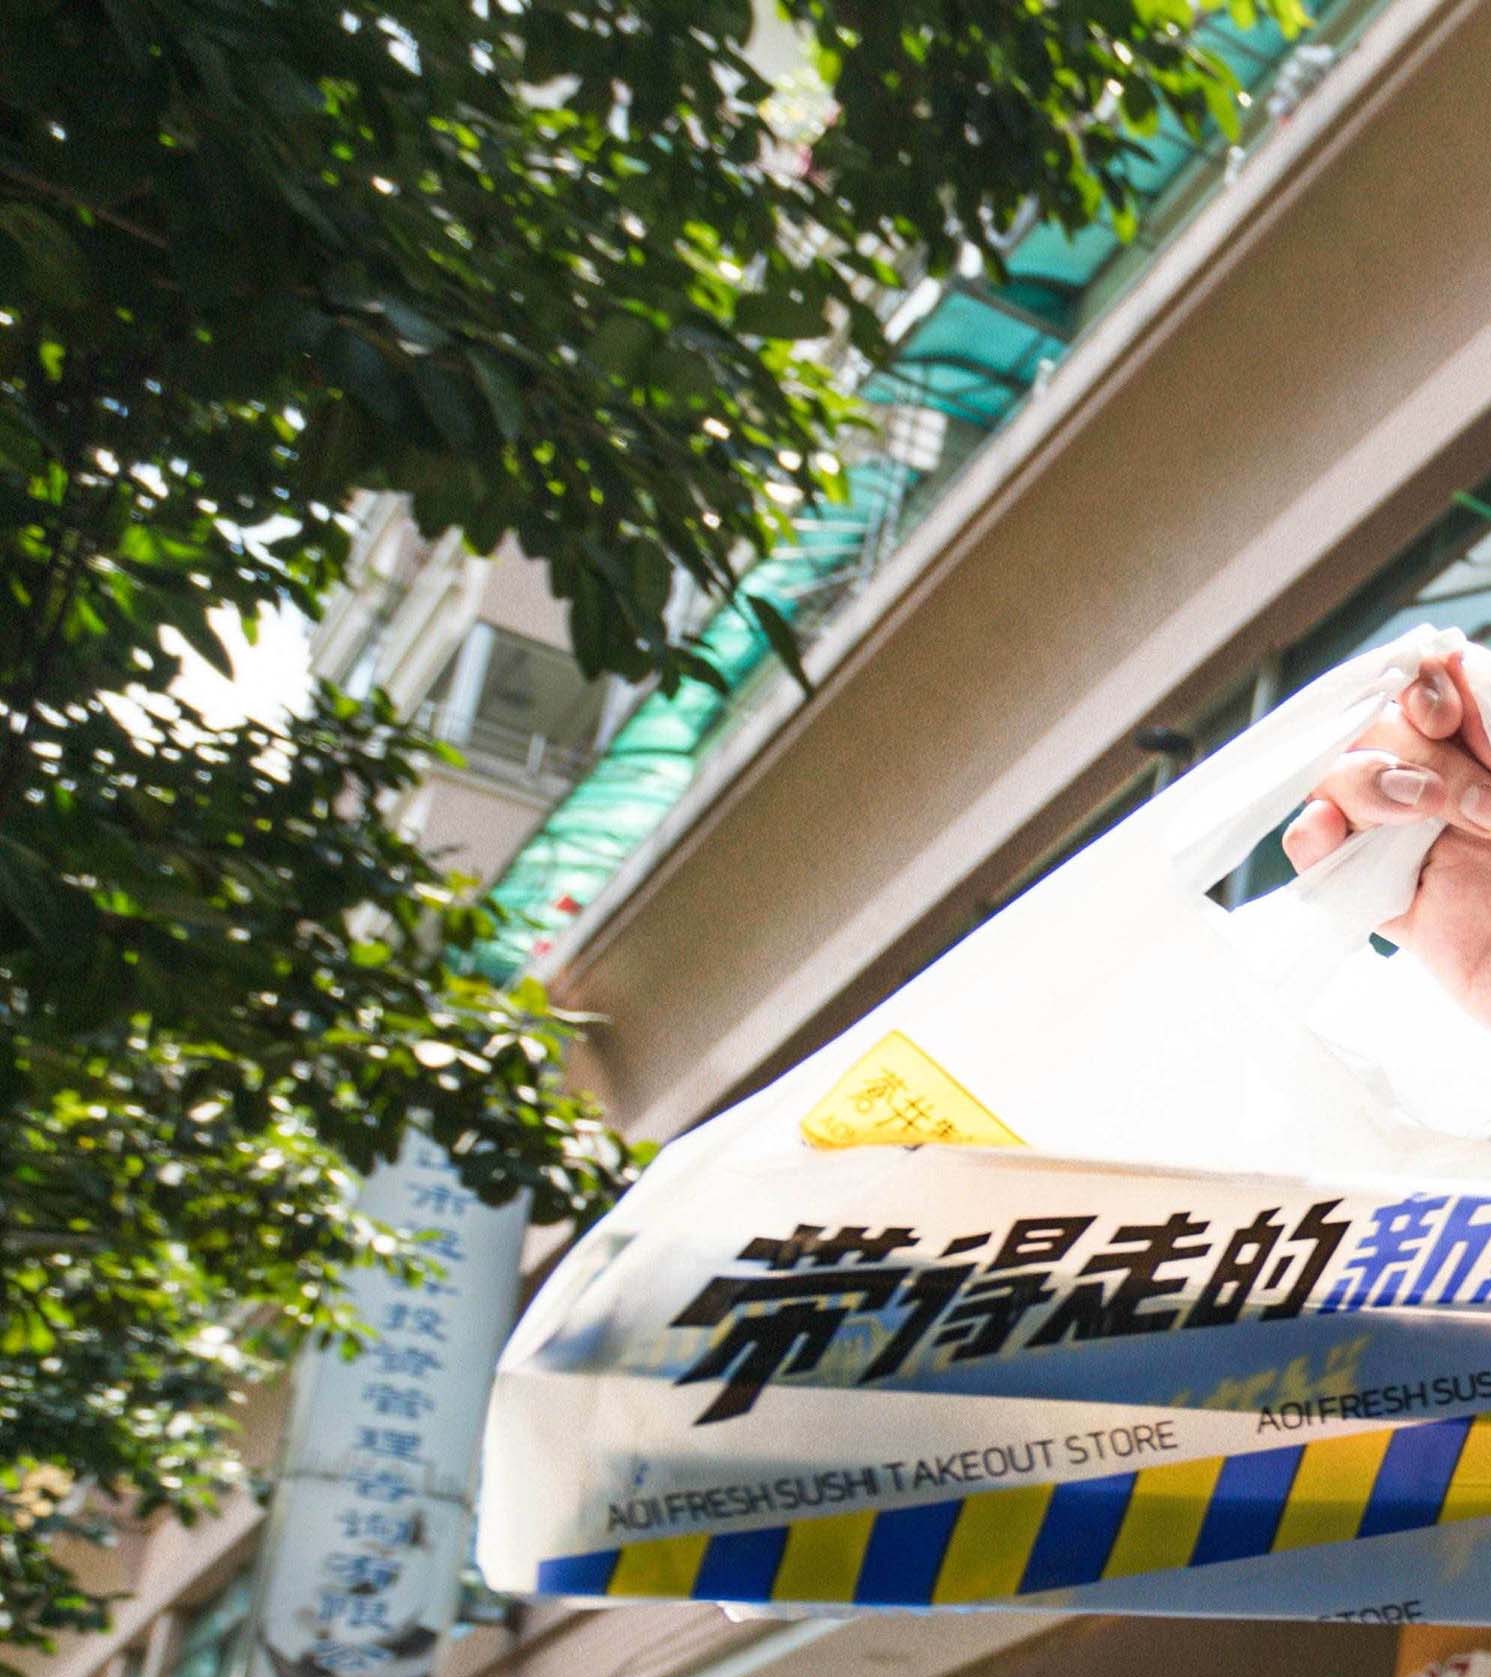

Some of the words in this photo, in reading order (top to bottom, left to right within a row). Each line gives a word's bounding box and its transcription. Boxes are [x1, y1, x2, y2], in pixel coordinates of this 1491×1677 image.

[1257, 1402, 1311, 1434] AOI
[1317, 1381, 1428, 1423] FRESH
[607, 1498, 661, 1533] AOI
[665, 1482, 776, 1523] FRESH
[773, 1465, 881, 1512] SUSHI
[884, 1439, 1054, 1491] TAKEOUT
[1065, 1420, 1179, 1465] STORE
